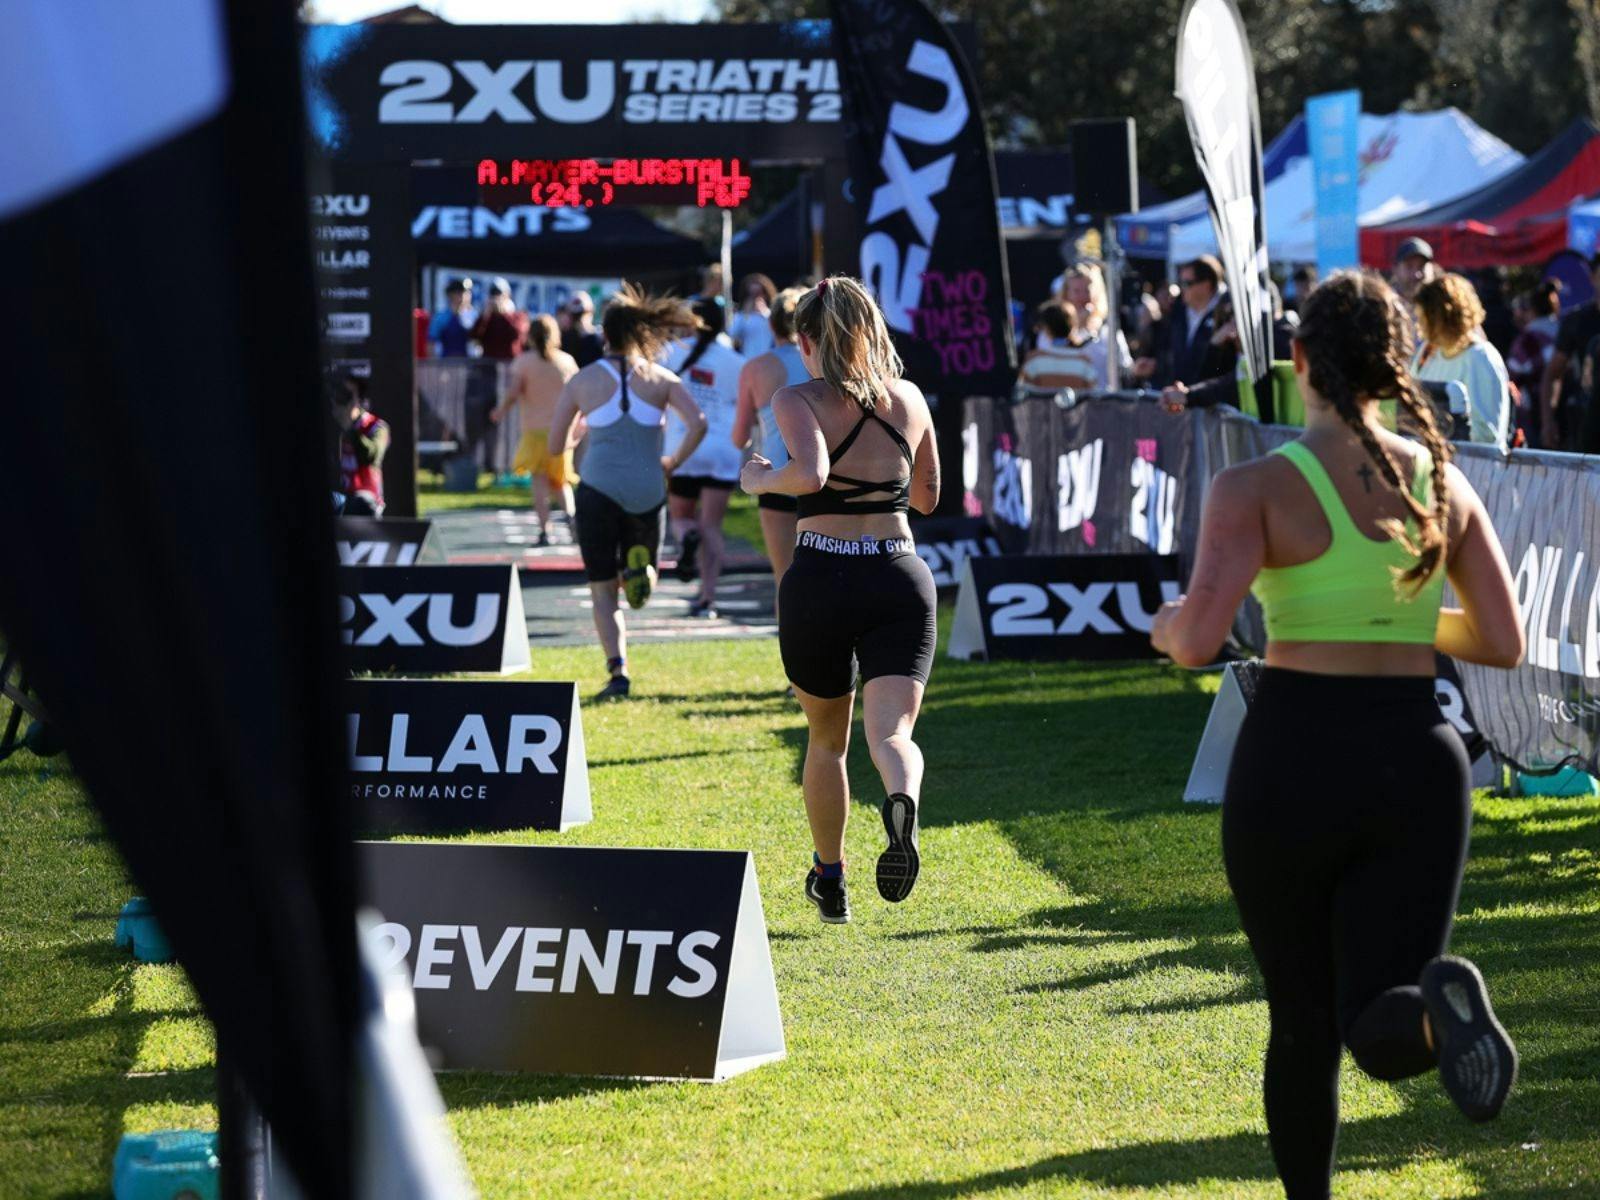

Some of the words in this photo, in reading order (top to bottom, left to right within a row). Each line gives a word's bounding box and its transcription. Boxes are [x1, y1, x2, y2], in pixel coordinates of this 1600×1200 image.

[378, 60, 615, 124] 2XU
[623, 93, 799, 123] SERIES
[919, 270, 987, 304] TWO
[904, 304, 991, 340] TIMES
[932, 338, 995, 375] YOU
